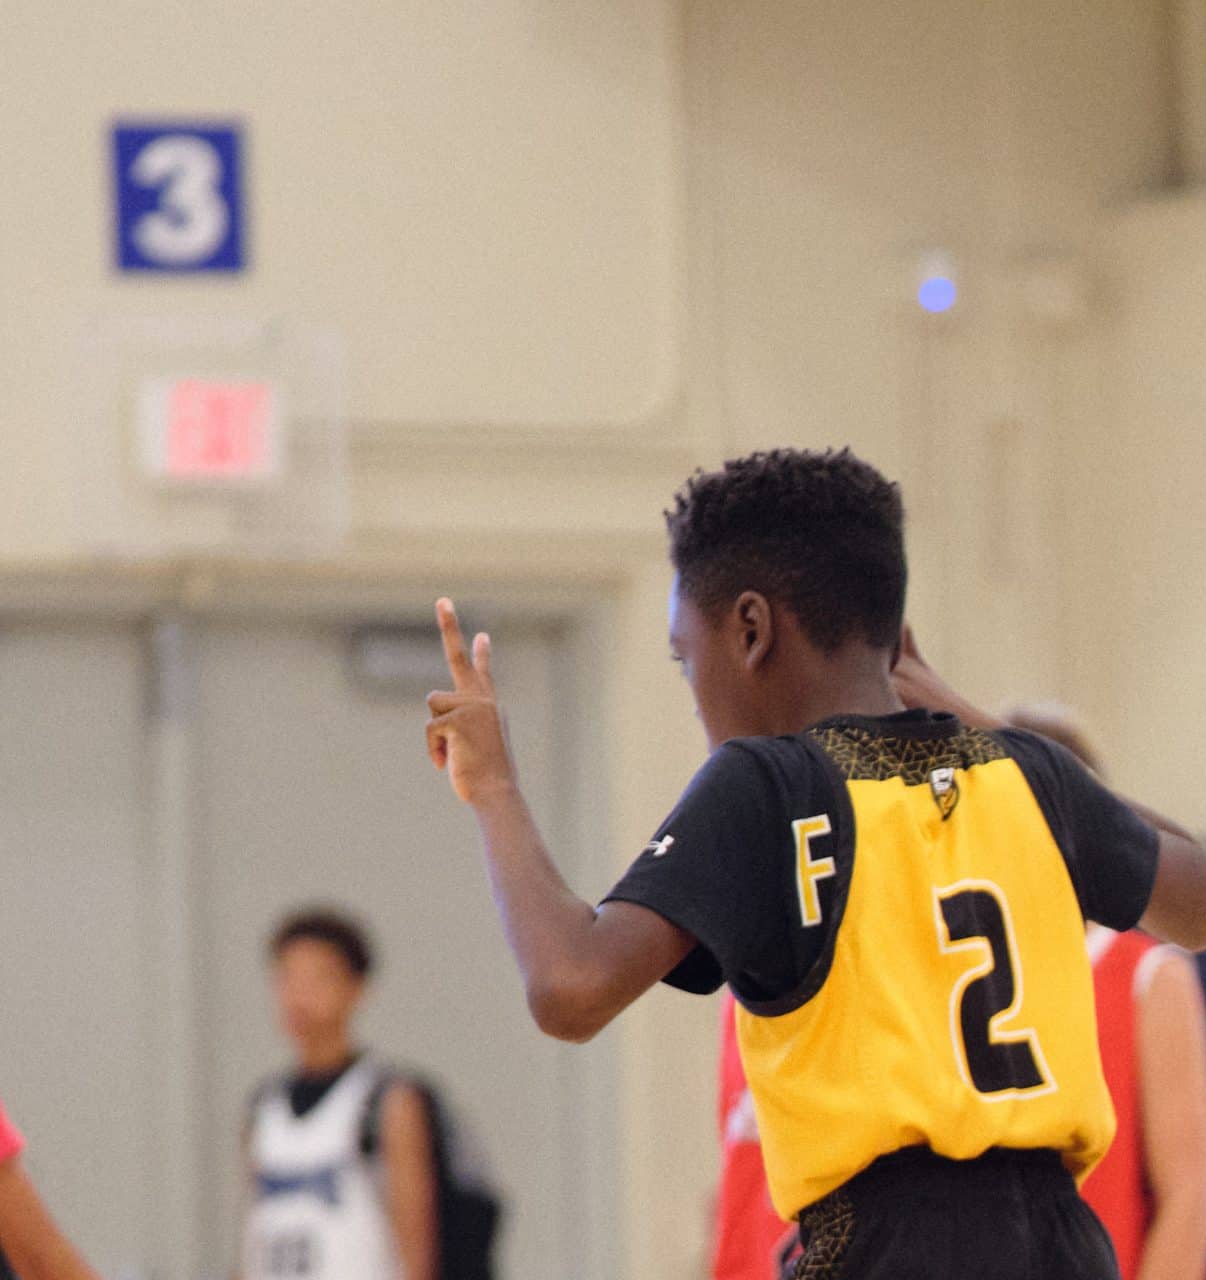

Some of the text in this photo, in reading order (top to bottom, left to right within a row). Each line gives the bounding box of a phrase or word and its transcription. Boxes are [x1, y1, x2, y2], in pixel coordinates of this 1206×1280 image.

[129, 135, 231, 265] 3
[791, 813, 837, 927] F
[932, 878, 1059, 1103] 2
